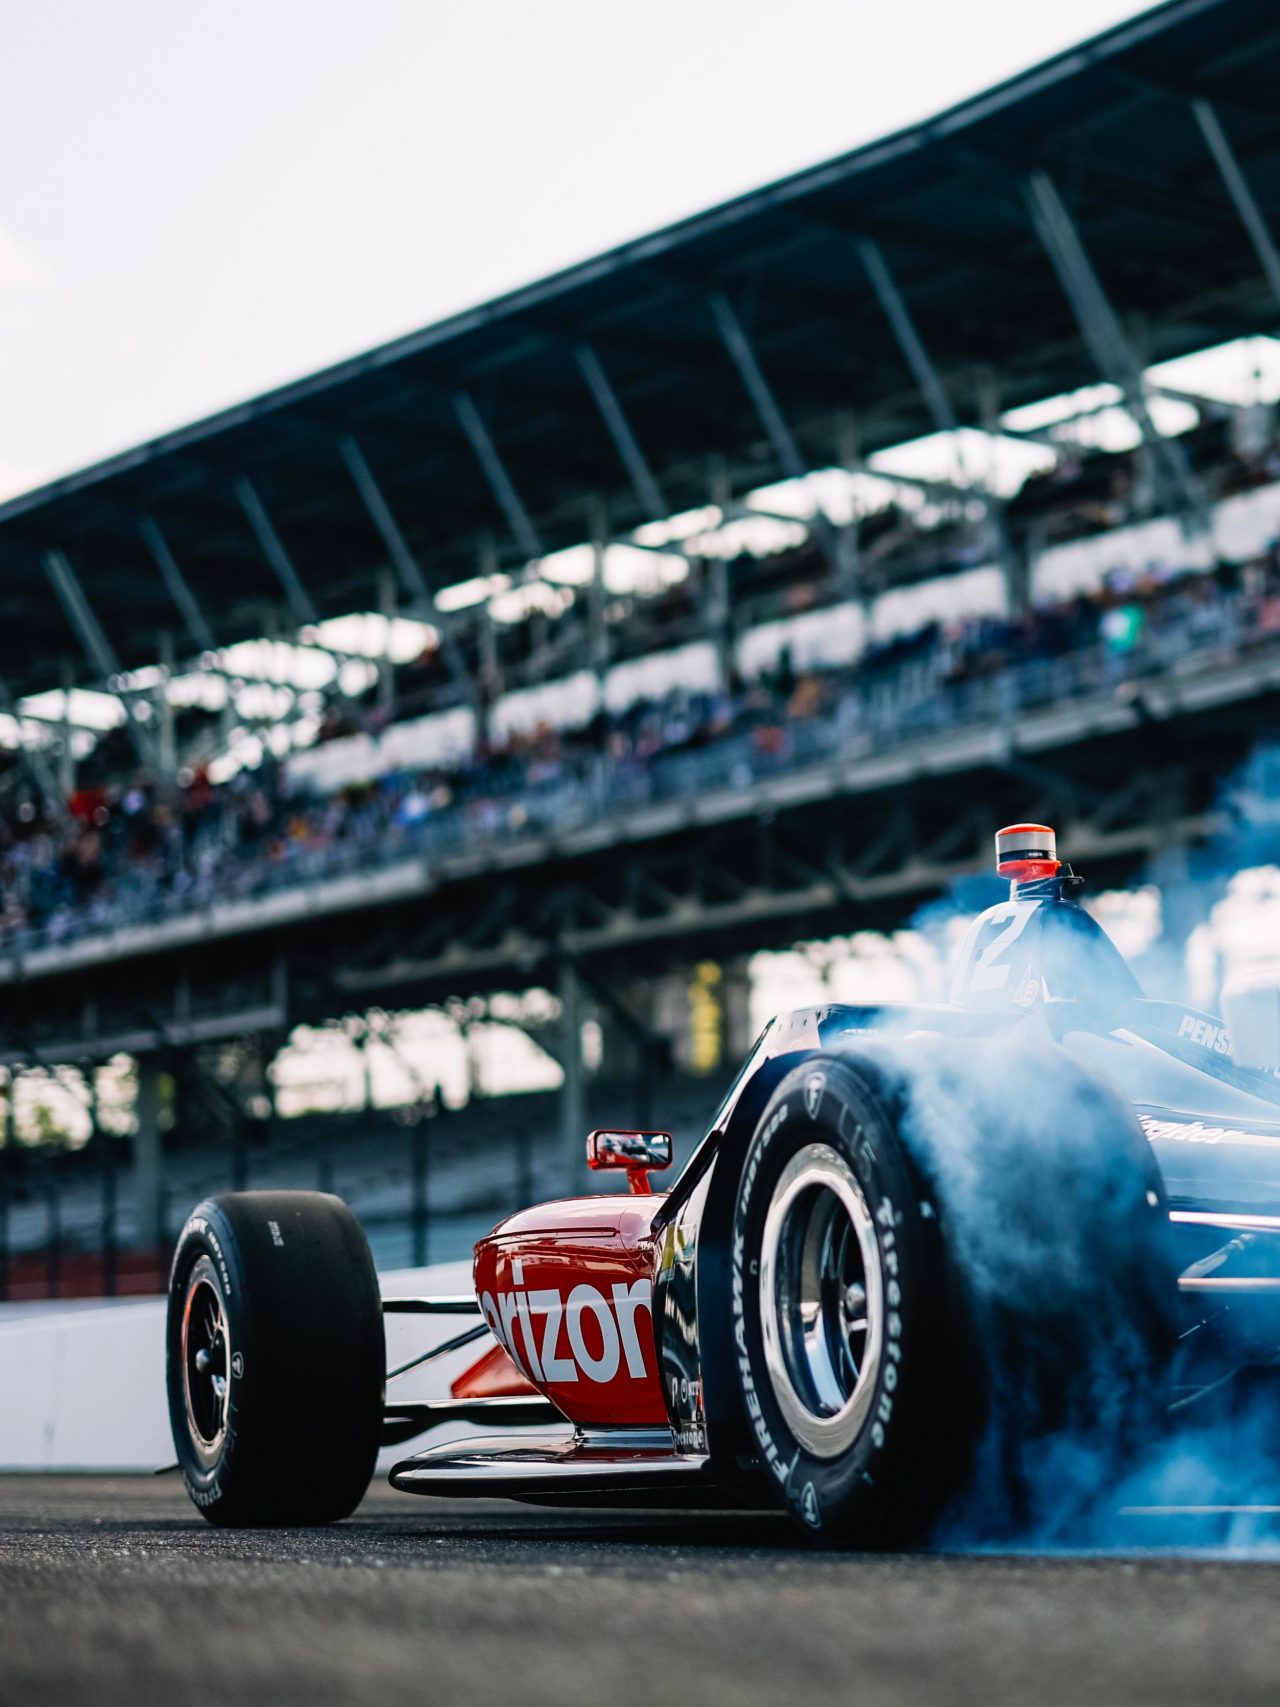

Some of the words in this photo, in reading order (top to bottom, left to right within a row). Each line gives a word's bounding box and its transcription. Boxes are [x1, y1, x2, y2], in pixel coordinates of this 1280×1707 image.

[1177, 1014, 1233, 1057] PENS
[732, 1226, 790, 1485] FIREHAWK
[871, 1196, 901, 1449] Firestone
